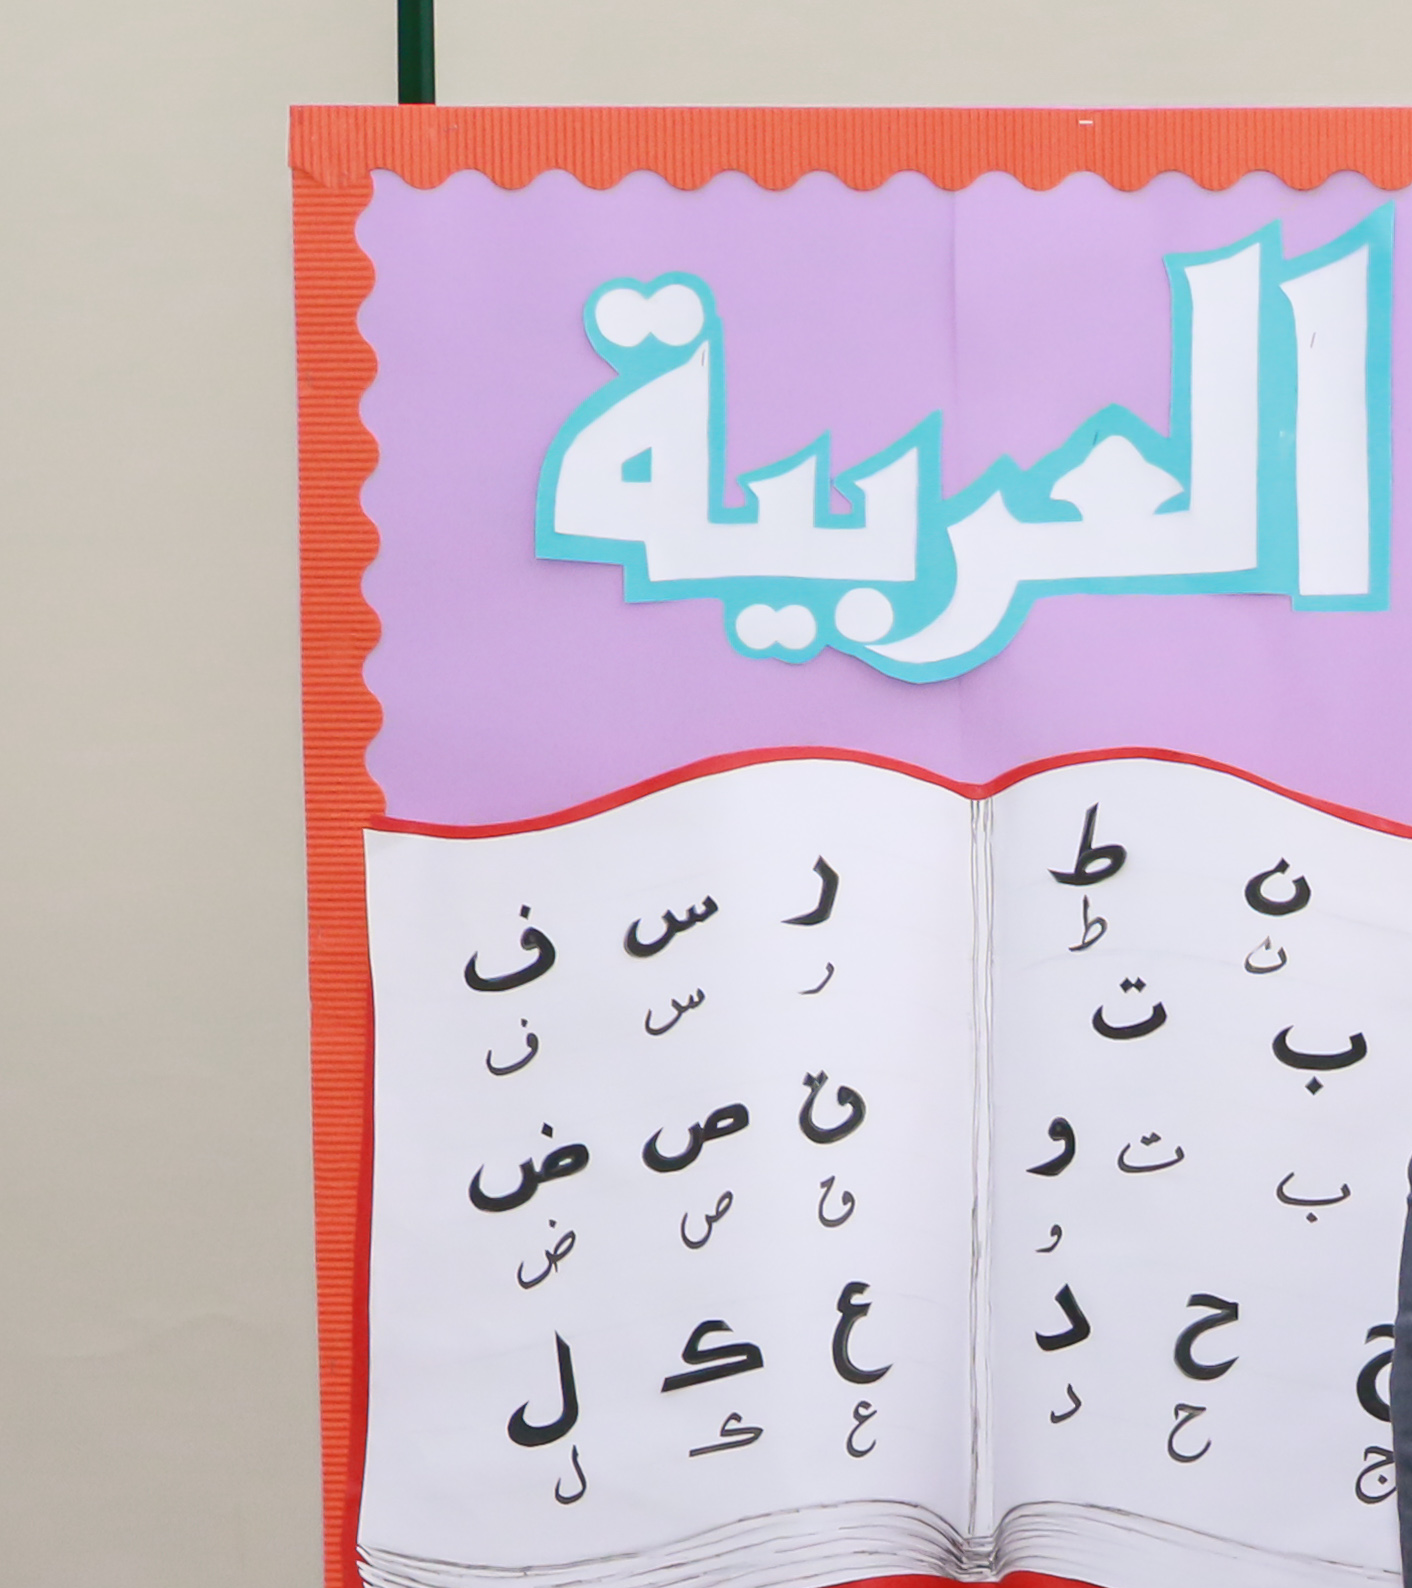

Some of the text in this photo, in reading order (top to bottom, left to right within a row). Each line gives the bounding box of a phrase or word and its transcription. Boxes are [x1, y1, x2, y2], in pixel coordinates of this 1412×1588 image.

[540, 208, 1392, 680] العربية
[1049, 803, 1127, 887] ط
[783, 856, 839, 926] ر
[1244, 858, 1311, 917] ن
[464, 903, 556, 993] ف
[624, 895, 719, 958] س
[1068, 895, 1107, 952] ط
[803, 962, 835, 995] ر
[1244, 938, 1288, 976] ن
[644, 988, 705, 1036] س
[1092, 977, 1168, 1040] ت
[486, 1018, 540, 1077] ف
[1272, 1026, 1368, 1096] ب
[799, 1071, 866, 1145] ق
[468, 1122, 590, 1213] ض
[642, 1103, 750, 1174] ص
[1026, 1117, 1076, 1177] و
[1117, 1131, 1185, 1174] ت
[680, 1191, 733, 1250] ص
[818, 1175, 857, 1228] ق
[1276, 1172, 1351, 1223] ب
[517, 1219, 577, 1290] ض
[1036, 1224, 1063, 1253] و
[832, 1281, 892, 1385] ع
[1035, 1283, 1091, 1352] د
[1174, 1293, 1241, 1381] ح
[507, 1332, 580, 1448] ل
[1050, 1383, 1082, 1424] د
[846, 1400, 878, 1458] ع
[1167, 1403, 1212, 1463] ح
[554, 1445, 588, 1505] ل
[1355, 1446, 1397, 1504] ج
